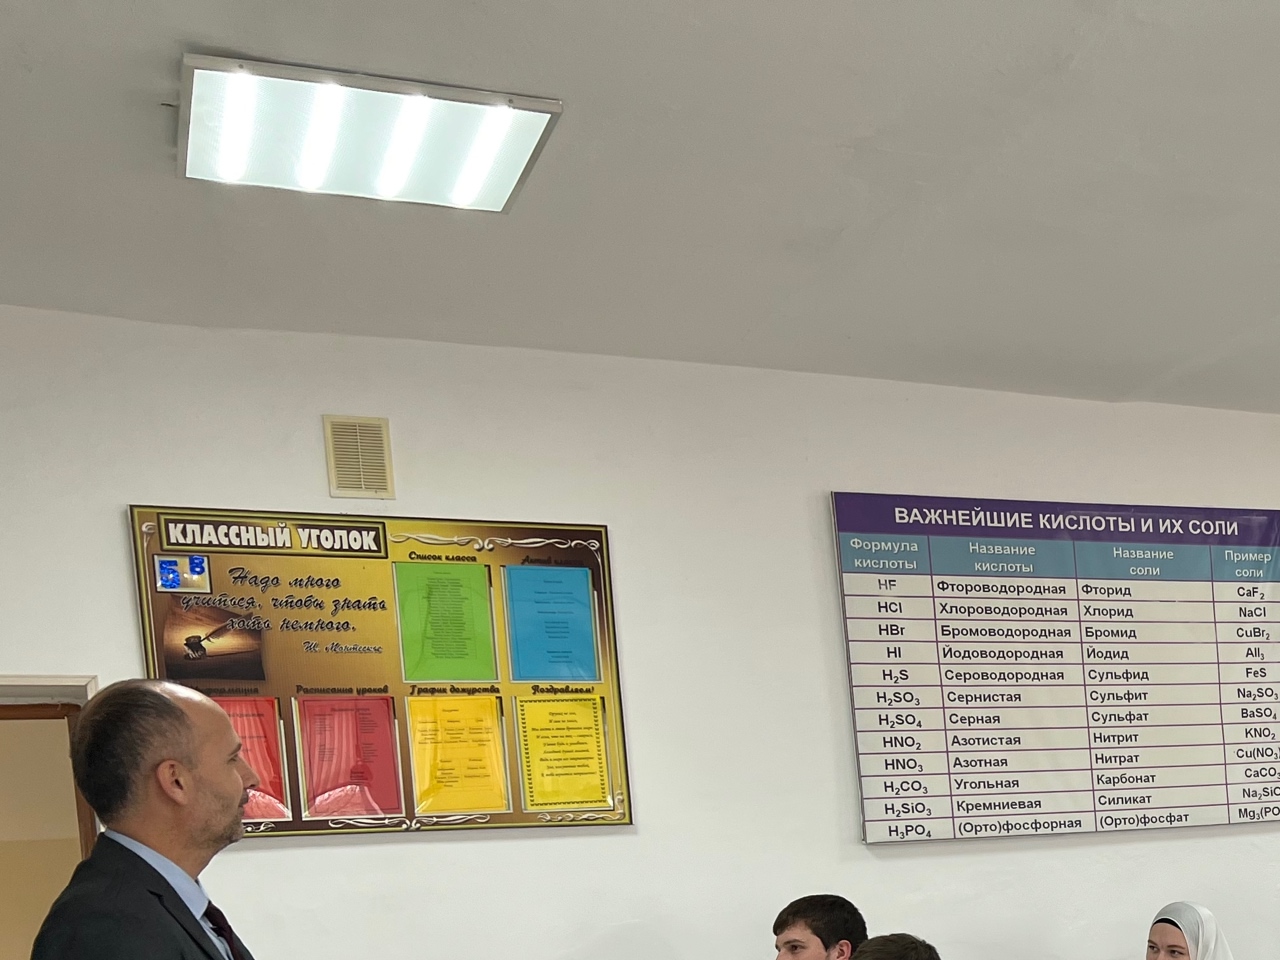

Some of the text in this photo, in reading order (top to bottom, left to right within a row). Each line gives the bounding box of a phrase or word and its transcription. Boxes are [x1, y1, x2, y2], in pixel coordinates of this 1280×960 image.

[894, 506, 1239, 536] ВАЖНЕЙШИЕ КИСЛОТЫ И ИХ СОЛИ
[168, 522, 379, 550] КЛАССНЫЙ УГОЛОК
[850, 539, 918, 554] Формула
[969, 542, 1036, 557] Название
[408, 551, 477, 562] Список класса
[1113, 547, 1174, 560] Название
[1225, 550, 1272, 564] Пример
[854, 557, 917, 570] кислоты
[975, 560, 1034, 573] кислоты
[1129, 565, 1160, 575] соли
[158, 559, 181, 589] 5
[1236, 567, 1263, 578] соли
[228, 566, 341, 593] Надо много
[878, 578, 897, 591] HF
[936, 581, 1067, 597] Фтороводородная
[1081, 584, 1132, 598] Фторид
[181, 593, 387, 615] учиться, чтобы знать
[878, 601, 903, 614] HCl
[939, 603, 1068, 618] Хлороводородная
[1083, 605, 1134, 619] Хлорид
[1239, 607, 1266, 618] NaCl
[227, 616, 356, 632] хоть немного.
[878, 624, 905, 636] HBr
[940, 625, 1072, 640] Бромоводородная
[1085, 626, 1137, 640] Бромид
[886, 646, 902, 659] HI
[942, 645, 1065, 661] Йодоводородная
[1086, 646, 1129, 661] Йодид
[944, 669, 1065, 683] Сероводородная
[1088, 669, 1150, 682] Сульфид
[1246, 668, 1267, 678] FeS
[357, 685, 389, 695] уроков
[409, 685, 447, 695] График
[947, 690, 1022, 703] Сернистая
[1090, 690, 1149, 704] Сульфит
[949, 713, 1001, 726] Серная
[1091, 710, 1149, 725] Сульфат
[951, 734, 1022, 747] Азотистая
[1093, 732, 1140, 744] Нитрит
[953, 756, 1008, 768] Азотная
[1095, 753, 1140, 764] Нитрат
[954, 778, 1020, 791] Угольная
[1097, 773, 1156, 786] Карбонат
[956, 798, 1042, 812] Кремниевая
[1098, 794, 1152, 807] Силикат
[958, 817, 1082, 835] (Орто)фосфорная
[1099, 811, 1190, 828] (Орто)фосфат
